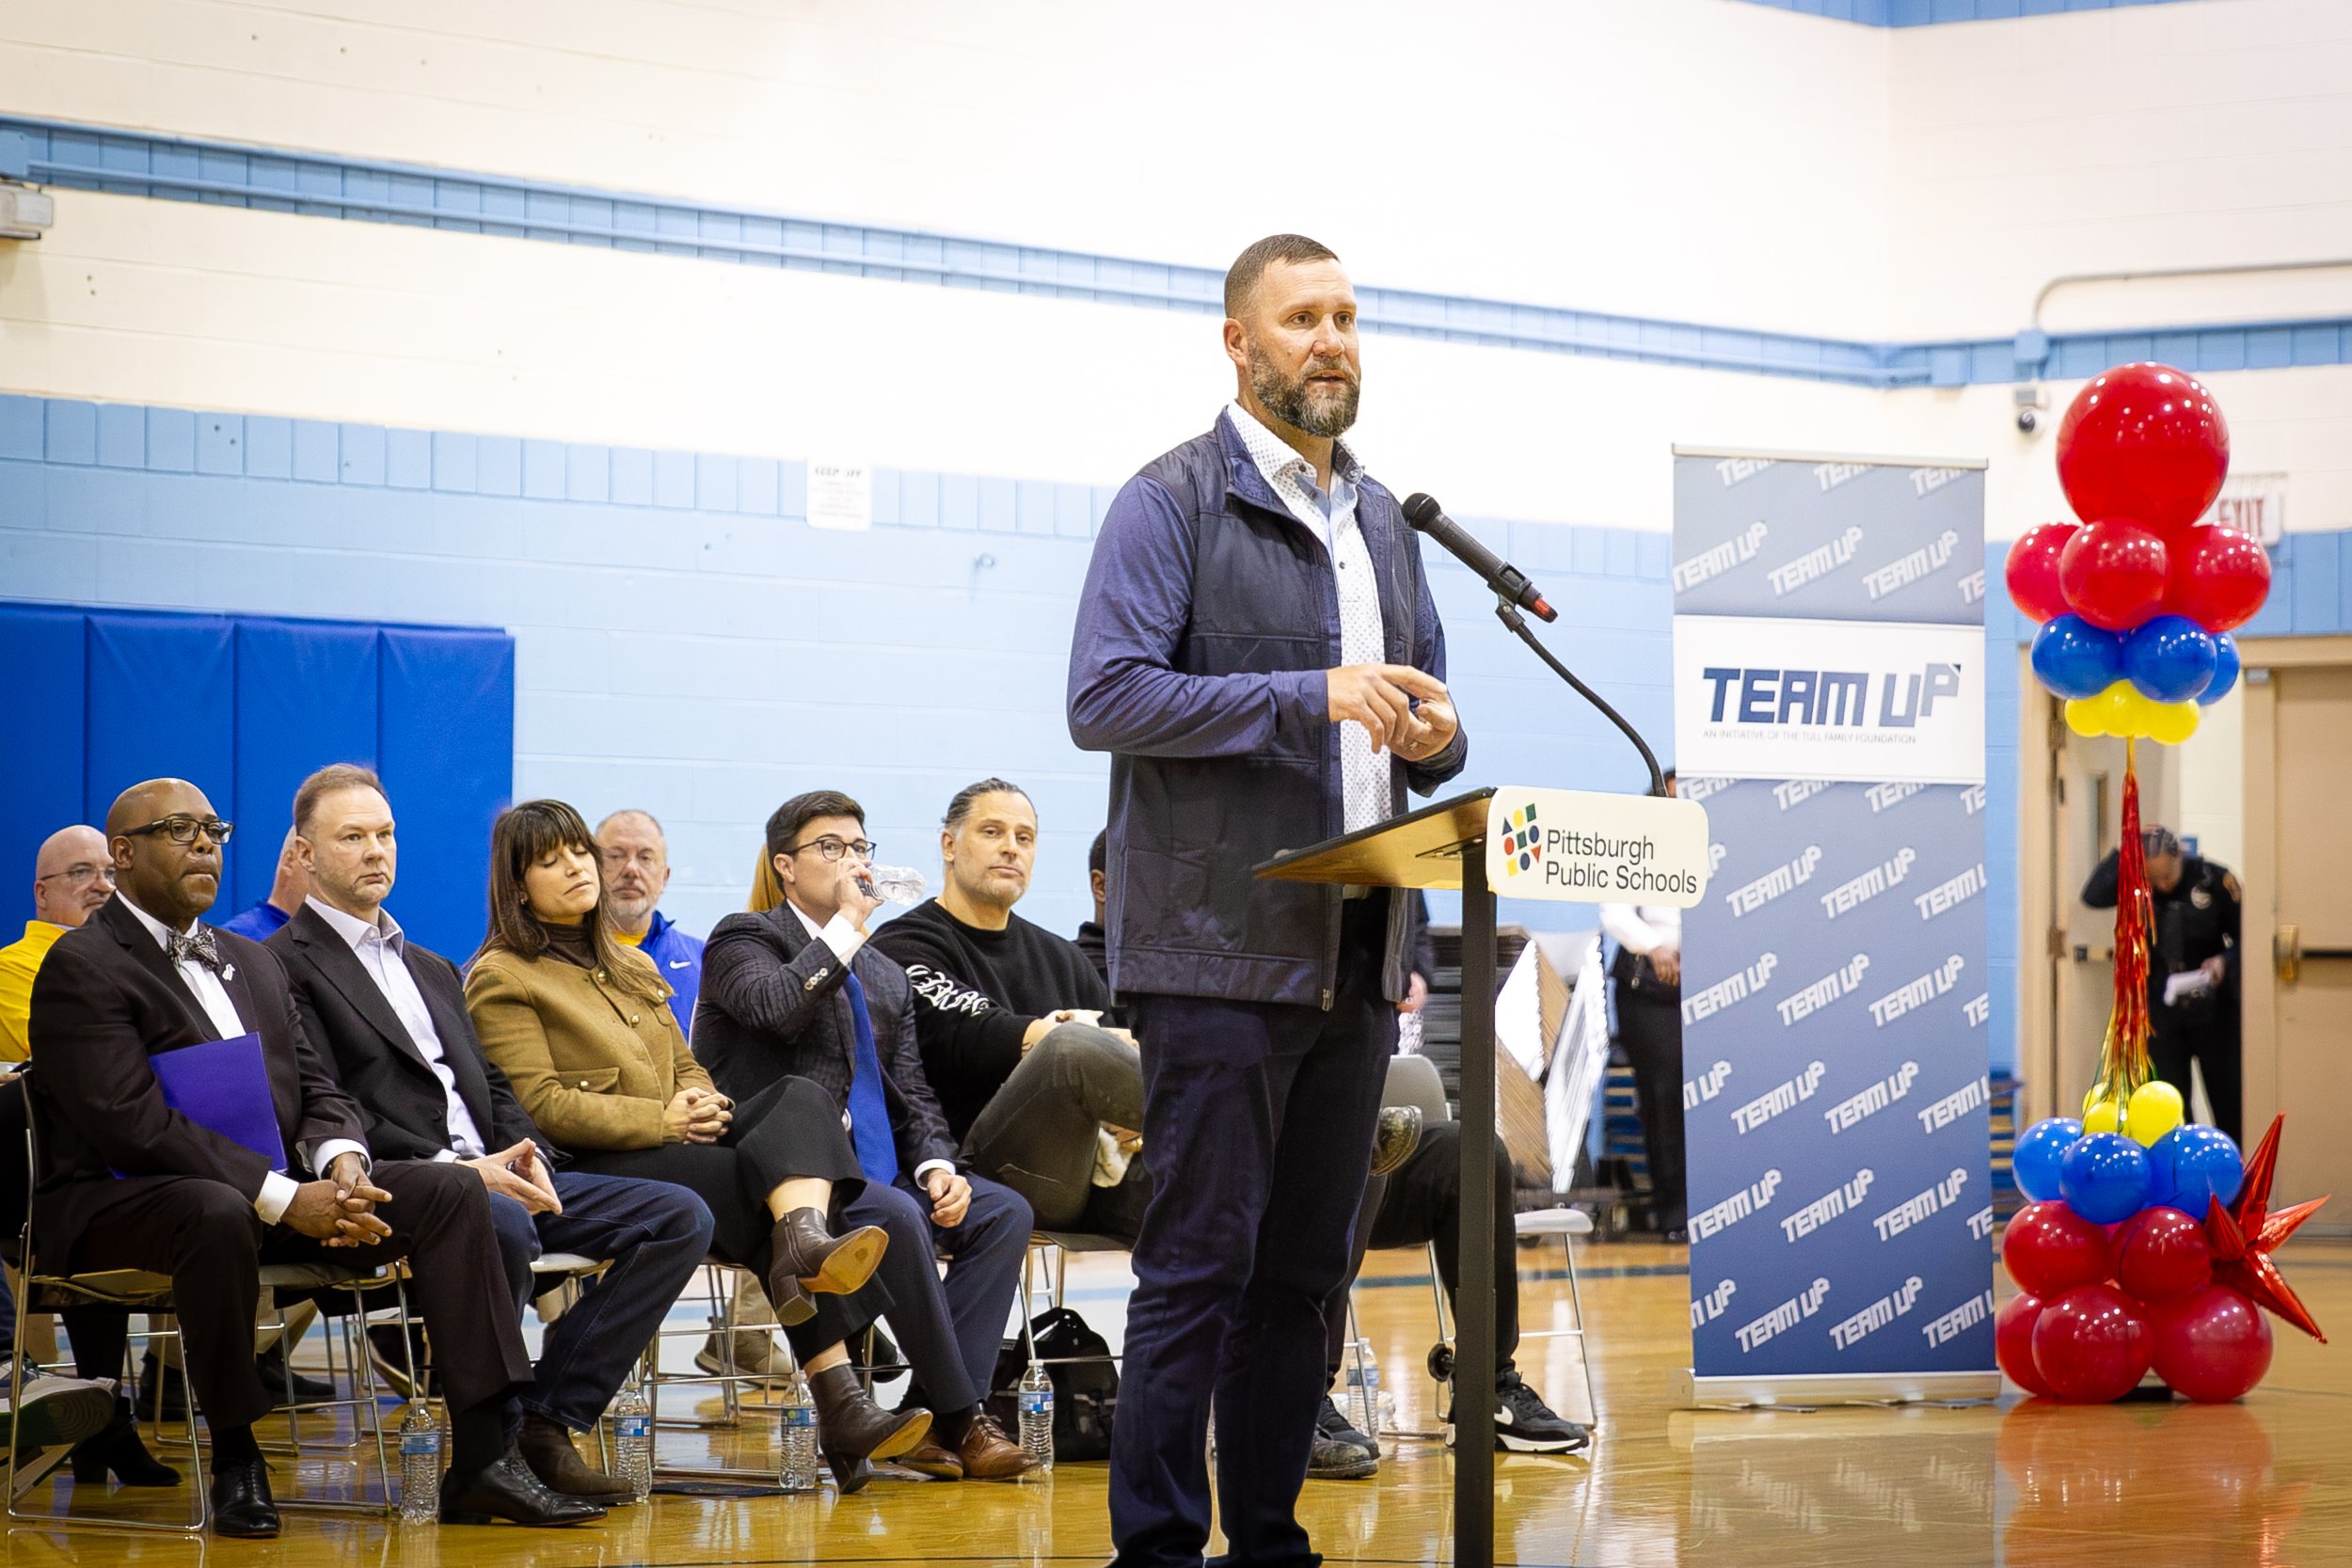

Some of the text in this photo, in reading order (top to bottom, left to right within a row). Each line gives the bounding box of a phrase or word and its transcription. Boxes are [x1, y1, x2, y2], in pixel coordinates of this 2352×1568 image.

[1672, 521, 1768, 594] TEAM UP
[1767, 526, 1864, 596] TEAM UP
[1862, 530, 1959, 600] TEAM UP
[1703, 662, 1962, 728] TEAM UP
[1703, 729, 1716, 738] AN
[1720, 729, 1765, 739] INITIATIVE
[1768, 730, 1779, 739] OF
[1783, 731, 1799, 741] THE
[1825, 733, 1853, 743] FAMILY
[1855, 734, 1916, 744] FOUNDATION
[1546, 861, 1697, 894] Public Schools
[1547, 829, 1654, 865] Pittsburgh
[1725, 845, 1821, 918] TEAM UP
[1820, 847, 1916, 919] TEAM UP
[1914, 867, 1979, 920] TEAM
[1681, 952, 1778, 1026] TEAM UP
[1776, 953, 1870, 1026] TEAM UP
[1868, 954, 1964, 1027] TEAM UP
[1698, 1060, 1732, 1101] UP
[1730, 1080, 1797, 1134] TEAM
[1796, 1060, 1825, 1101] UP
[1824, 1061, 1919, 1134] TEAM UP
[1917, 1081, 1981, 1134] TEAM
[1688, 1168, 1782, 1244] TEAM UP
[1780, 1168, 1874, 1243] TEAM UP
[1873, 1167, 1968, 1242] TEAM UP
[1705, 1278, 1737, 1320] UP
[1735, 1297, 1801, 1354] TEAM
[1800, 1276, 1831, 1319] UP
[1829, 1275, 1923, 1351] TEAM UP
[1922, 1294, 1985, 1349] TEAM
